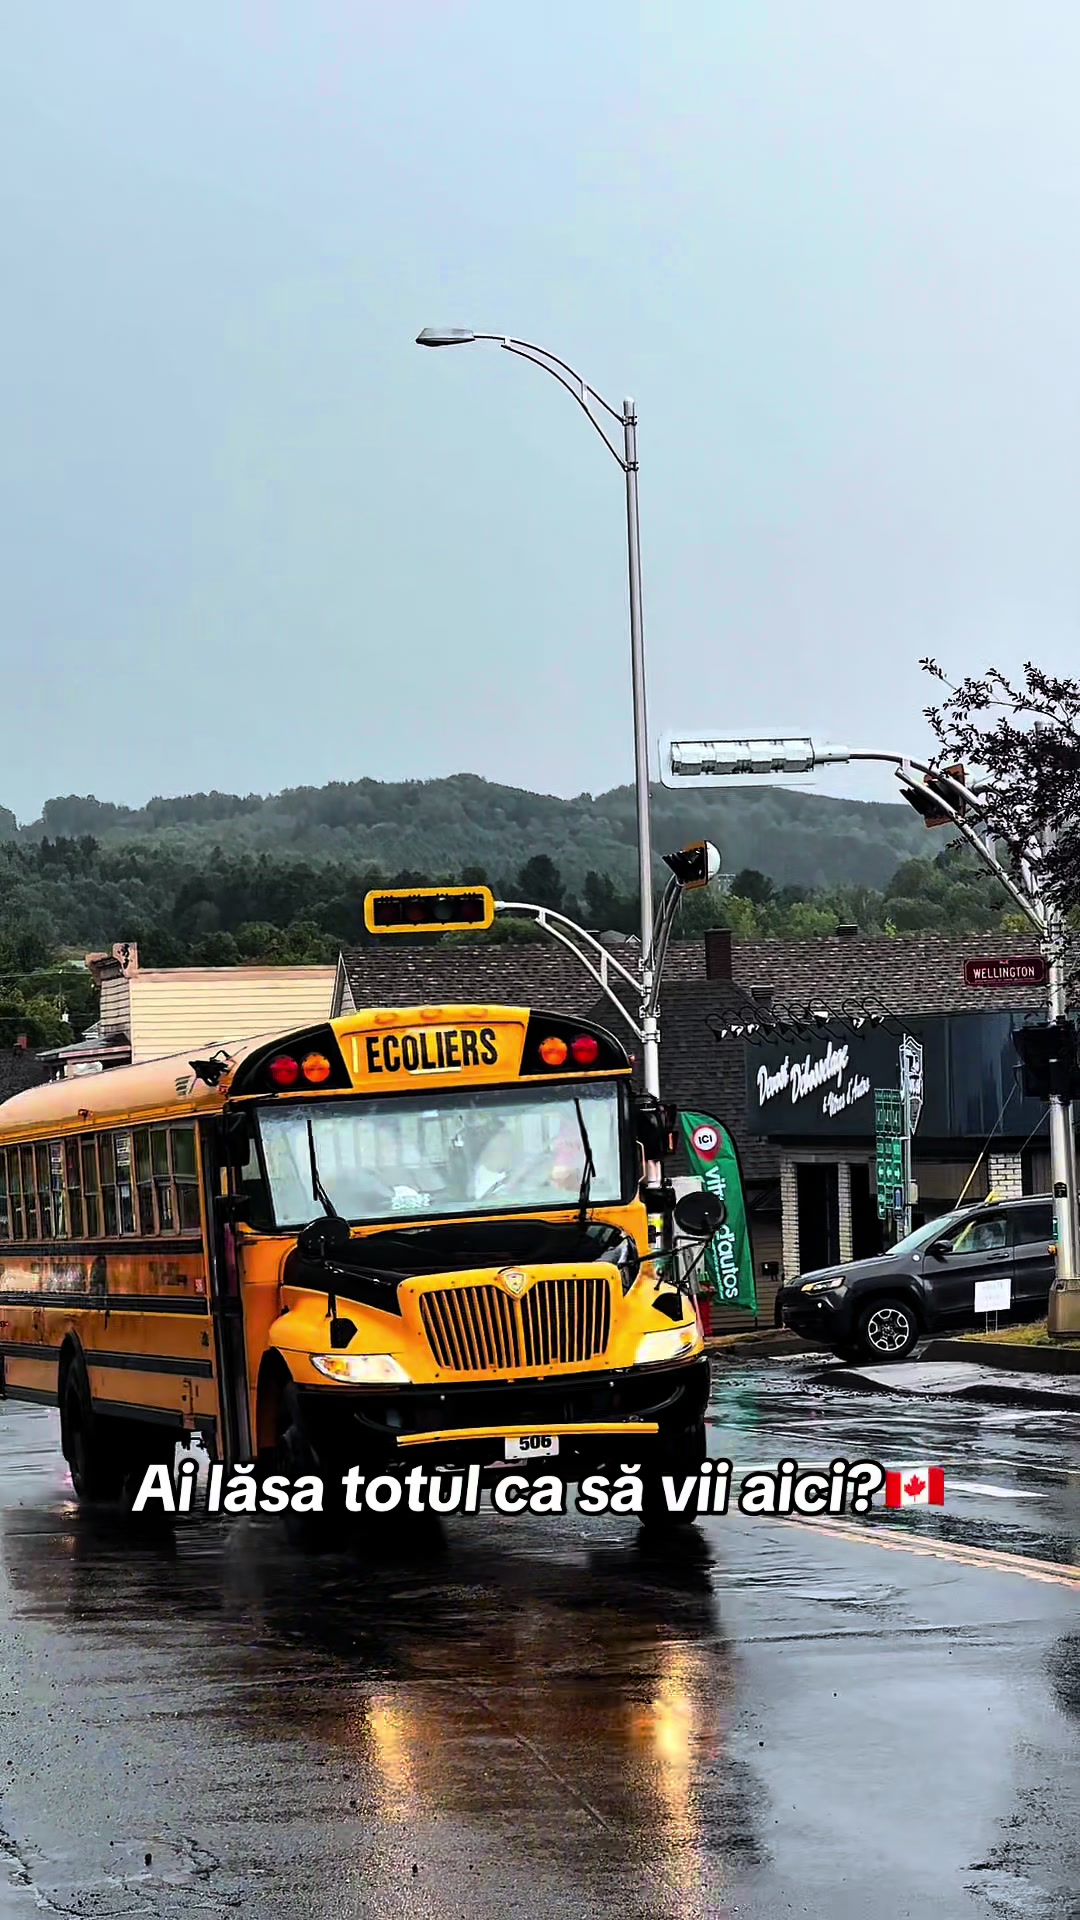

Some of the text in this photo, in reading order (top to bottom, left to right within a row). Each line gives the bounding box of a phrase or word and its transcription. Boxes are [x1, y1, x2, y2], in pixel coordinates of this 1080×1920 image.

[973, 966, 1035, 979] WELLINGTON
[365, 1028, 498, 1073] ECOLIERS
[698, 1135, 713, 1144] ICI
[716, 1224, 739, 1299] d'autos
[519, 1435, 552, 1451] 506
